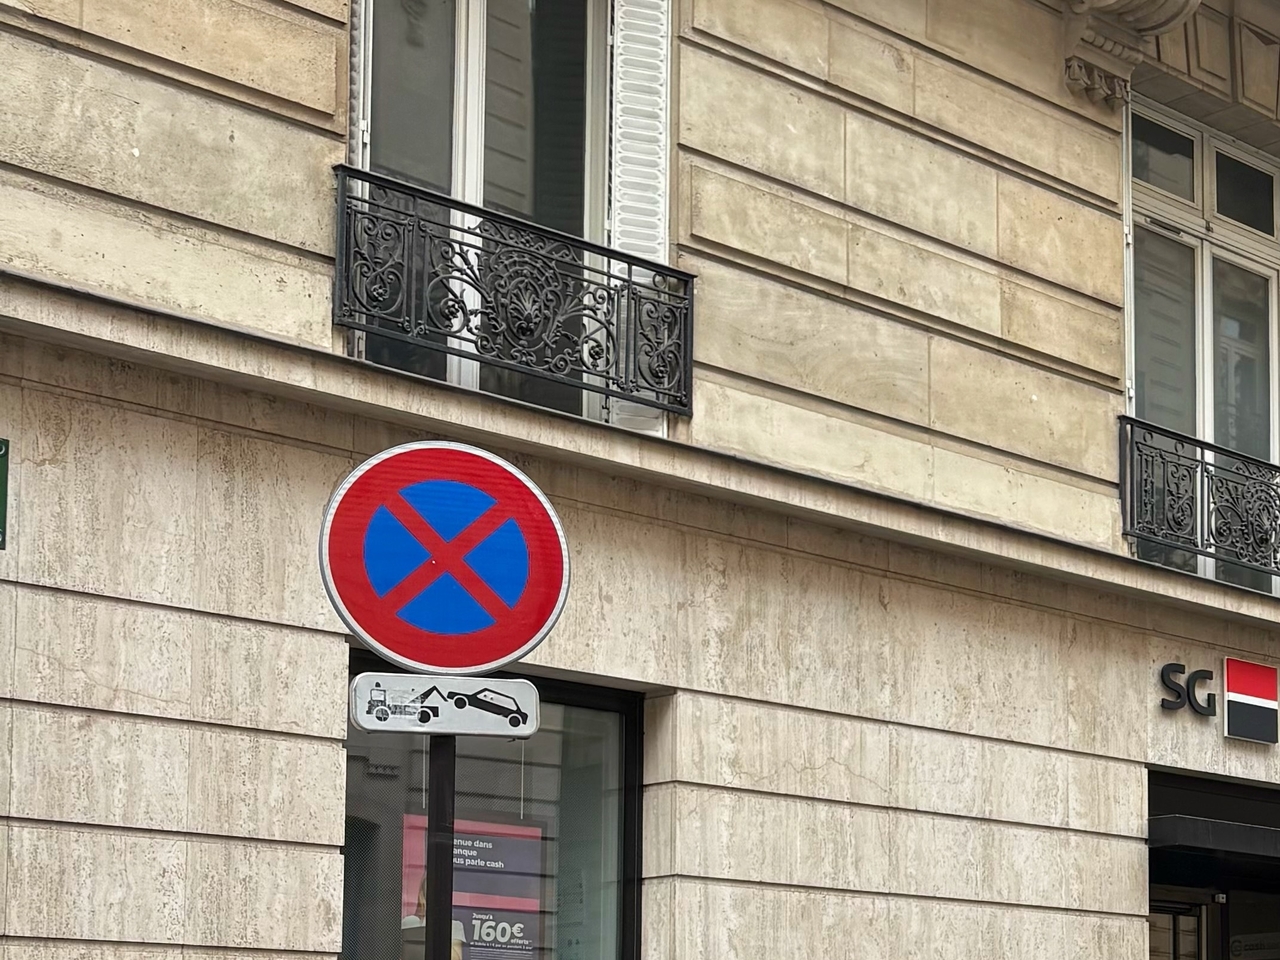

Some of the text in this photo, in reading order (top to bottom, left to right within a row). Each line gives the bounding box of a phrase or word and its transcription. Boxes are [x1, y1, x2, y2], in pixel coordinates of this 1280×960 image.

[1161, 663, 1217, 717] SG
[473, 840, 493, 849] dans
[453, 847, 478, 857] anque
[465, 858, 485, 867] parle
